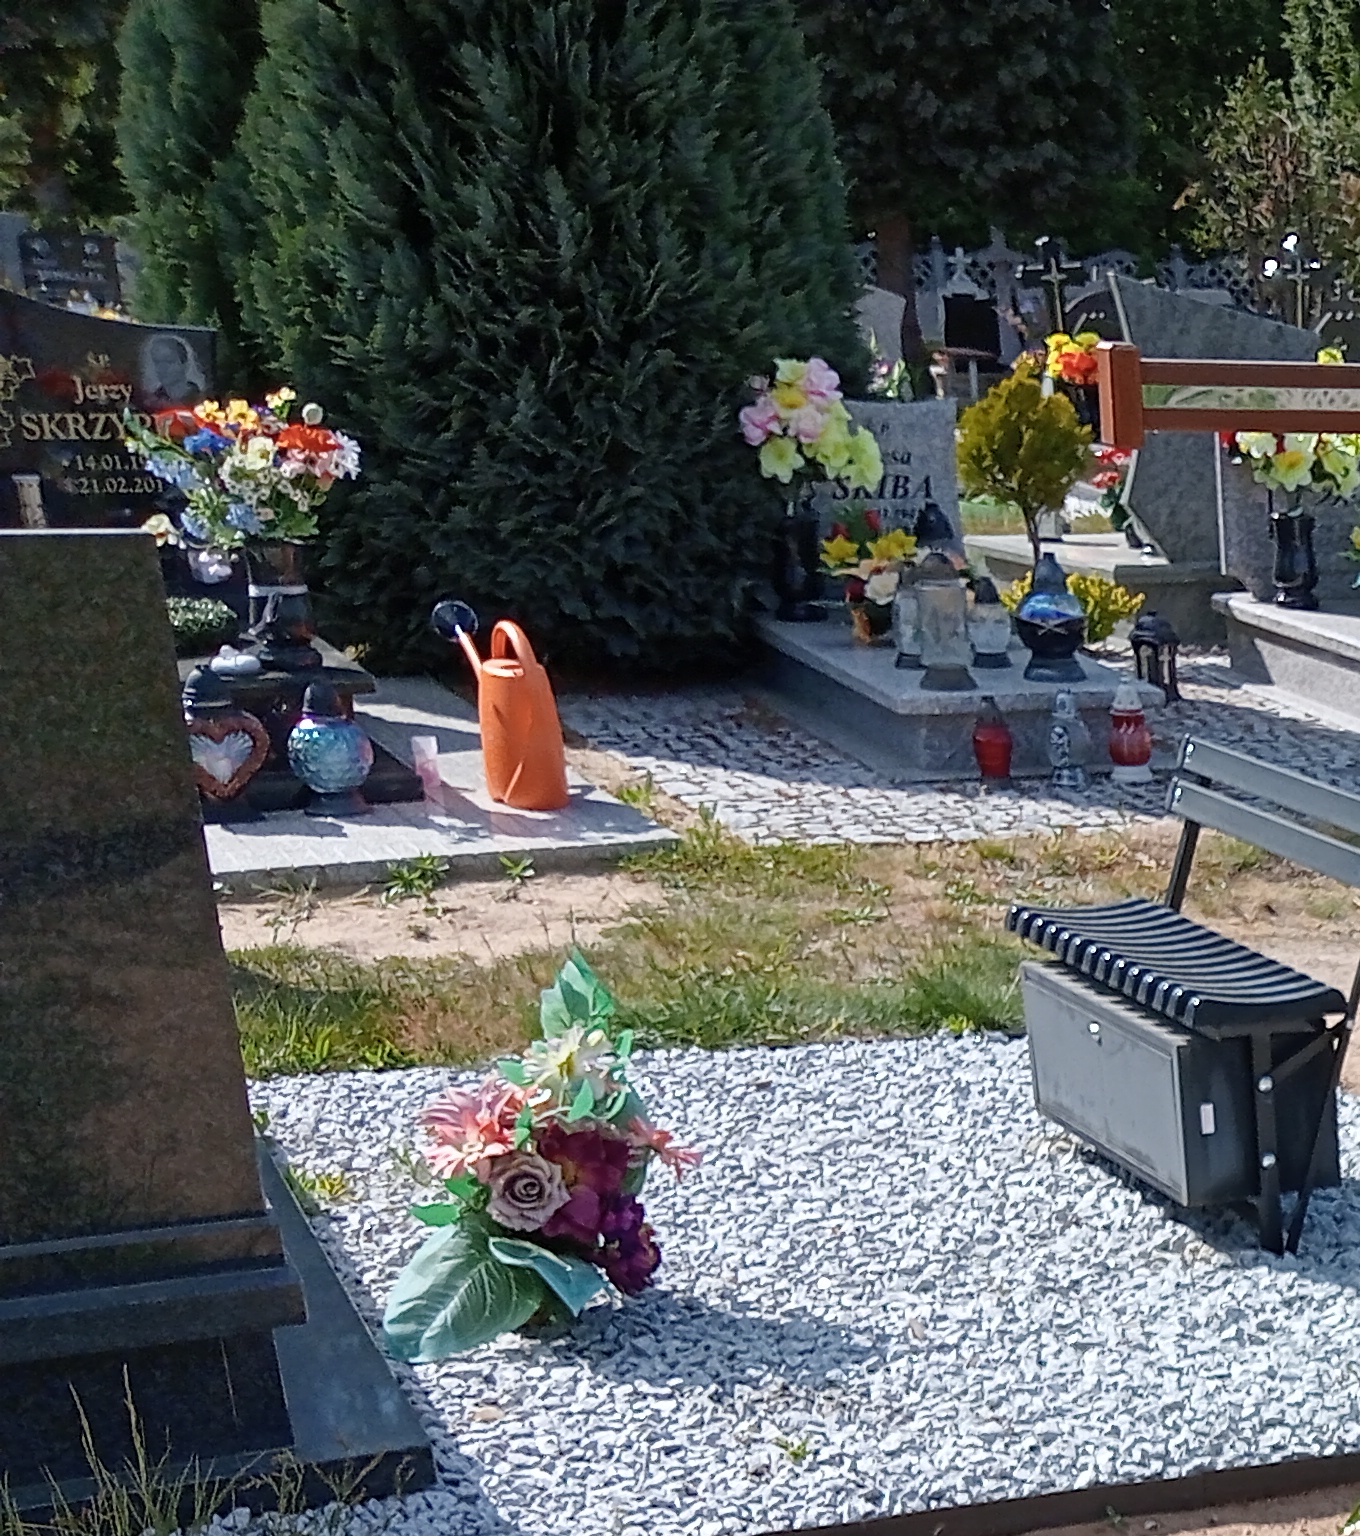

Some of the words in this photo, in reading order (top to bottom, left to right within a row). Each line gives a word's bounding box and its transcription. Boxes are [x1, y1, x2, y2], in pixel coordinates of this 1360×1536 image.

[71, 375, 133, 404] Jerzy
[21, 412, 152, 441] SKRZYP
[78, 476, 164, 494] 21.02.201
